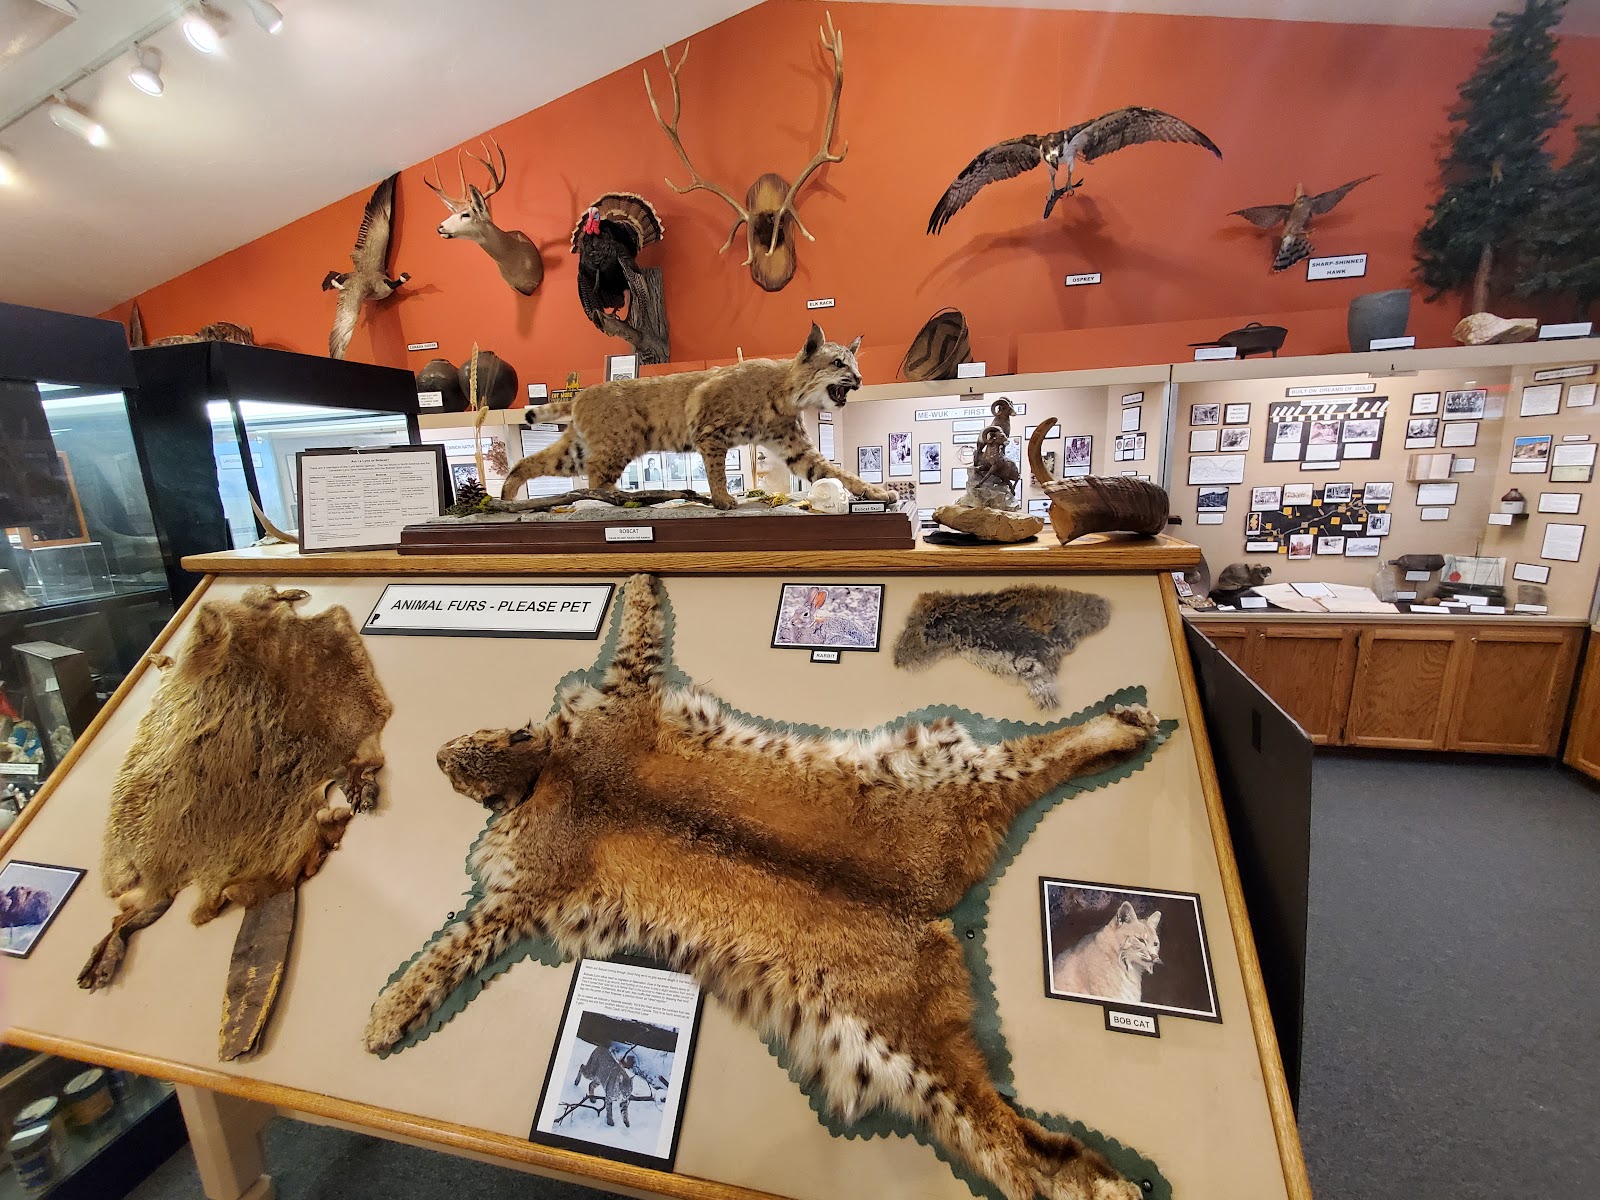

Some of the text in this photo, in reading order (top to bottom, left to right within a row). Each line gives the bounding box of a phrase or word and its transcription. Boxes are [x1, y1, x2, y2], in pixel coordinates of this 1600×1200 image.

[1311, 258, 1364, 268] SHARP-SHINNED
[390, 600, 443, 611] ANIMAL
[447, 600, 487, 611] FURS
[497, 600, 557, 612] PLEASE
[560, 601, 591, 613] PET
[1114, 1016, 1150, 1028] BOB CAT
